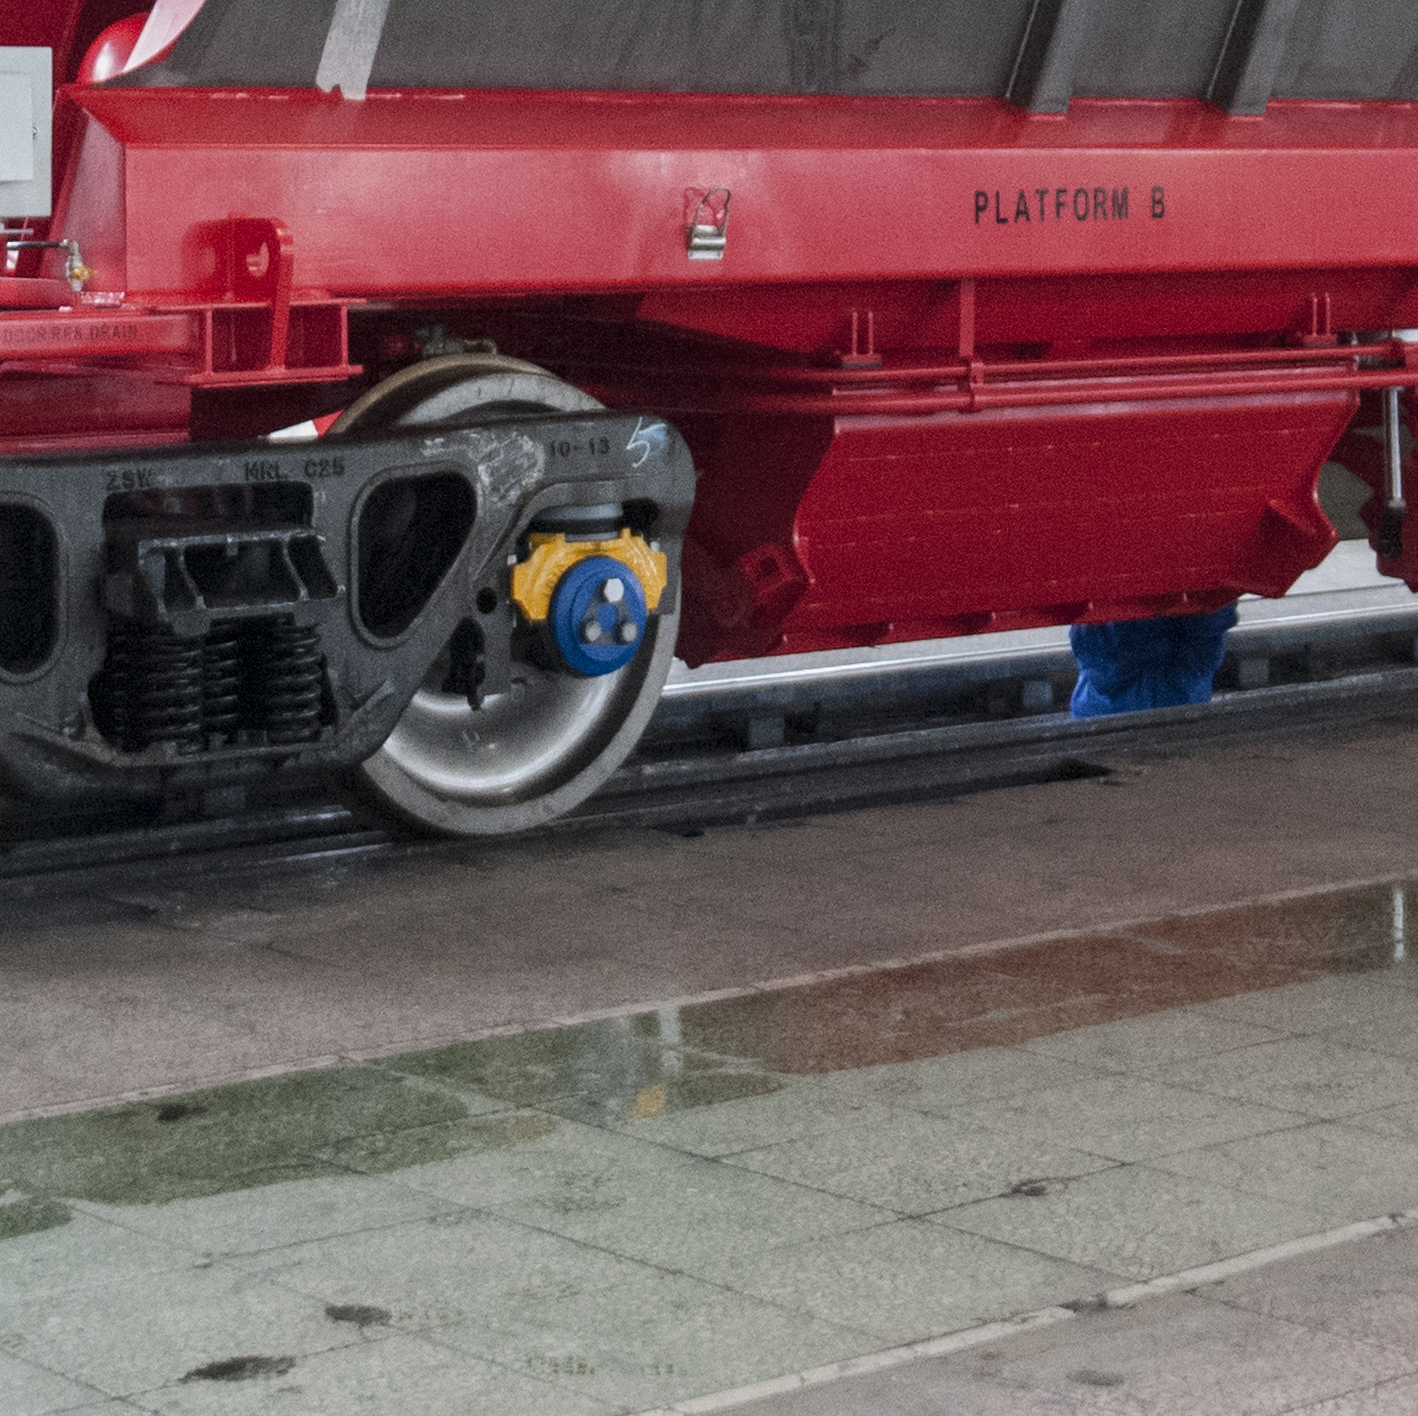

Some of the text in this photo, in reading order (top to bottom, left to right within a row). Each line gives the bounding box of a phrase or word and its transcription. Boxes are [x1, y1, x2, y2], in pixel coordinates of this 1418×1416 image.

[973, 185, 1166, 225] PLATFORM B
[626, 416, 667, 468] 5
